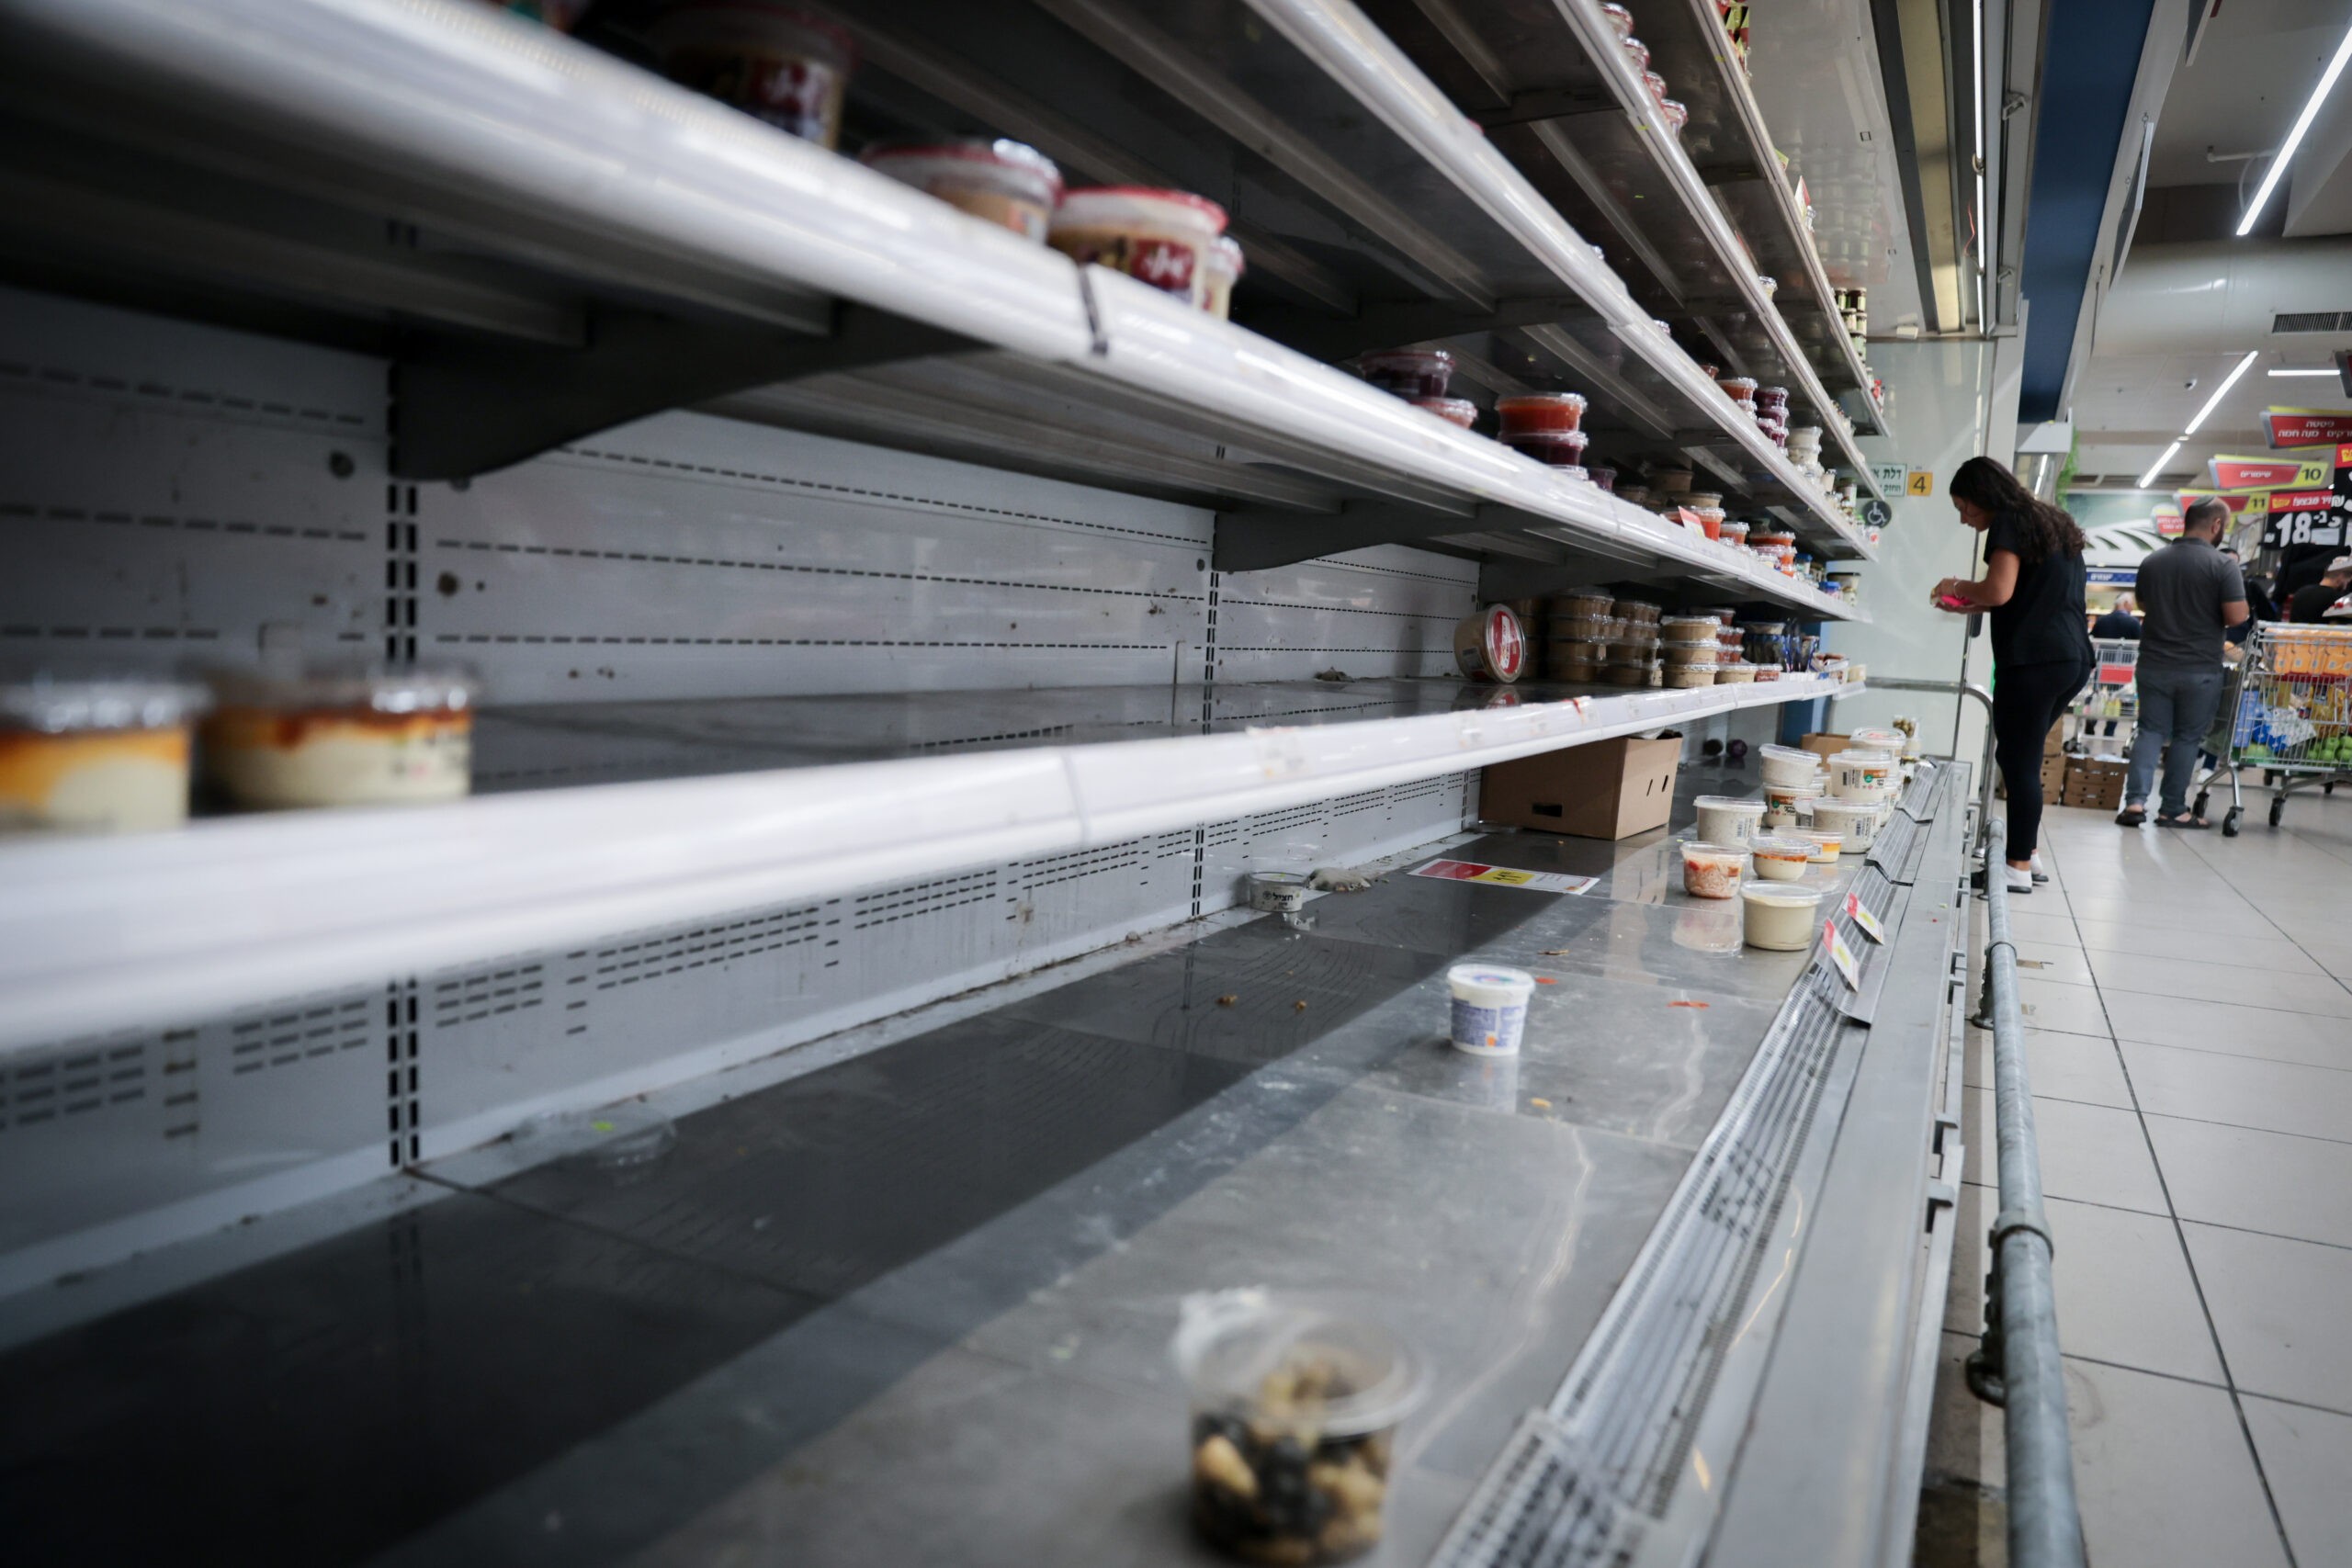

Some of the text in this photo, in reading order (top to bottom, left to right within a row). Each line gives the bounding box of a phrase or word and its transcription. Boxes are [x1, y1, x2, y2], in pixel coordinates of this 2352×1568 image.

[1883, 467, 1902, 479] דלת
[2301, 468, 2323, 481] 10
[1913, 475, 1926, 493] 4
[2252, 498, 2267, 509] 11
[2275, 512, 2312, 548] 18
[1272, 892, 1294, 901] חציל
